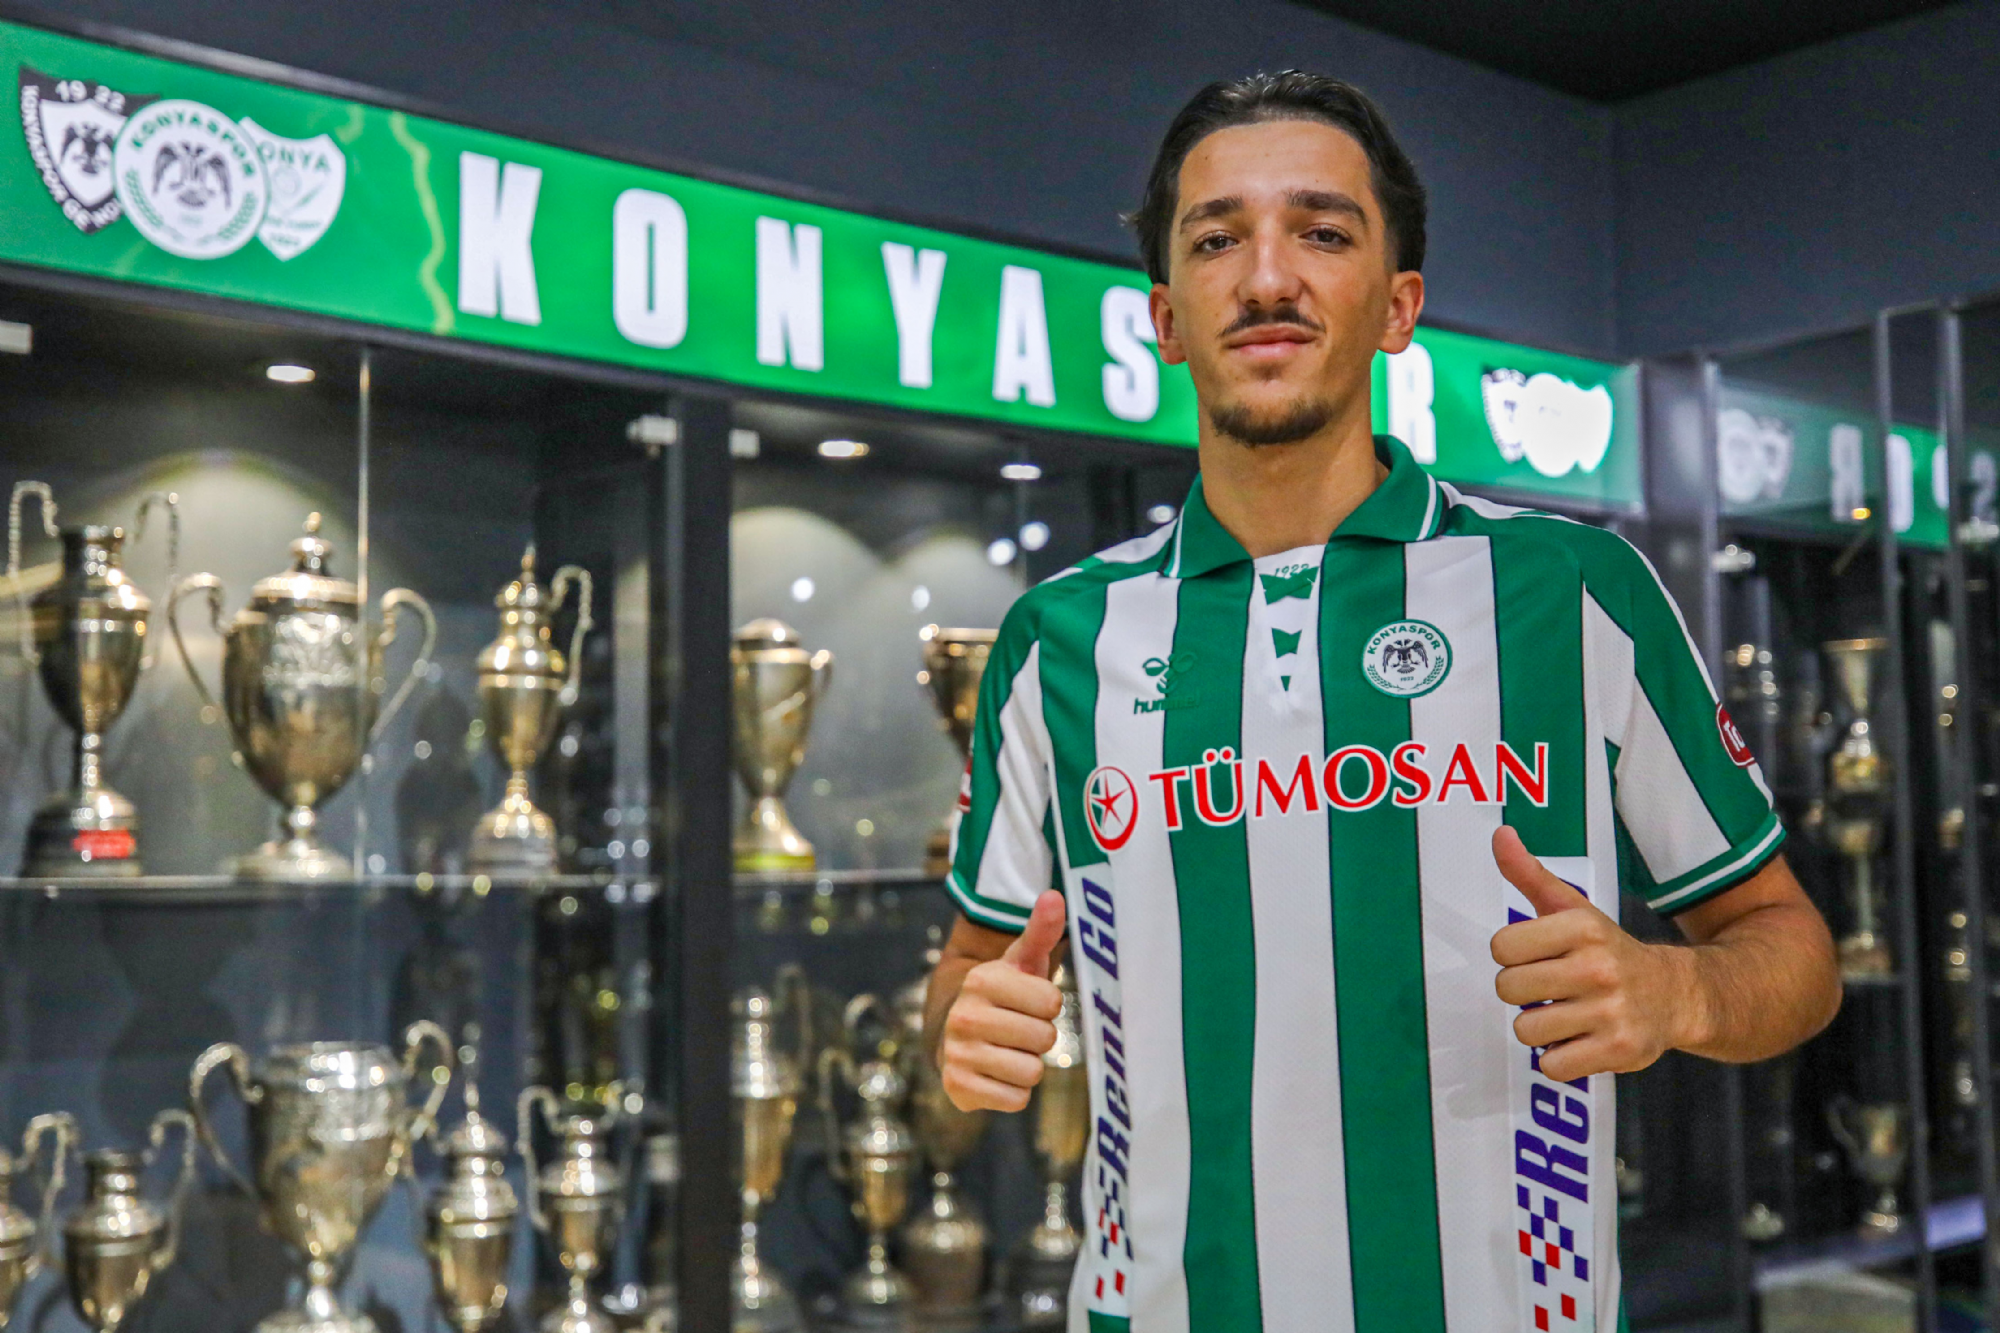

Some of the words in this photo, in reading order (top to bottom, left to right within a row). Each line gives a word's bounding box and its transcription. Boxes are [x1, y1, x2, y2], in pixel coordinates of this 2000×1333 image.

[131, 110, 255, 178] KONYASPOR
[257, 140, 332, 173] ONYA
[457, 151, 1437, 465] KONYASR
[1366, 625, 1442, 655] KONYASPOR
[1148, 743, 1549, 831] TÜMOSAN
[1078, 876, 1119, 981] Go
[1092, 988, 1132, 1186] Rent
